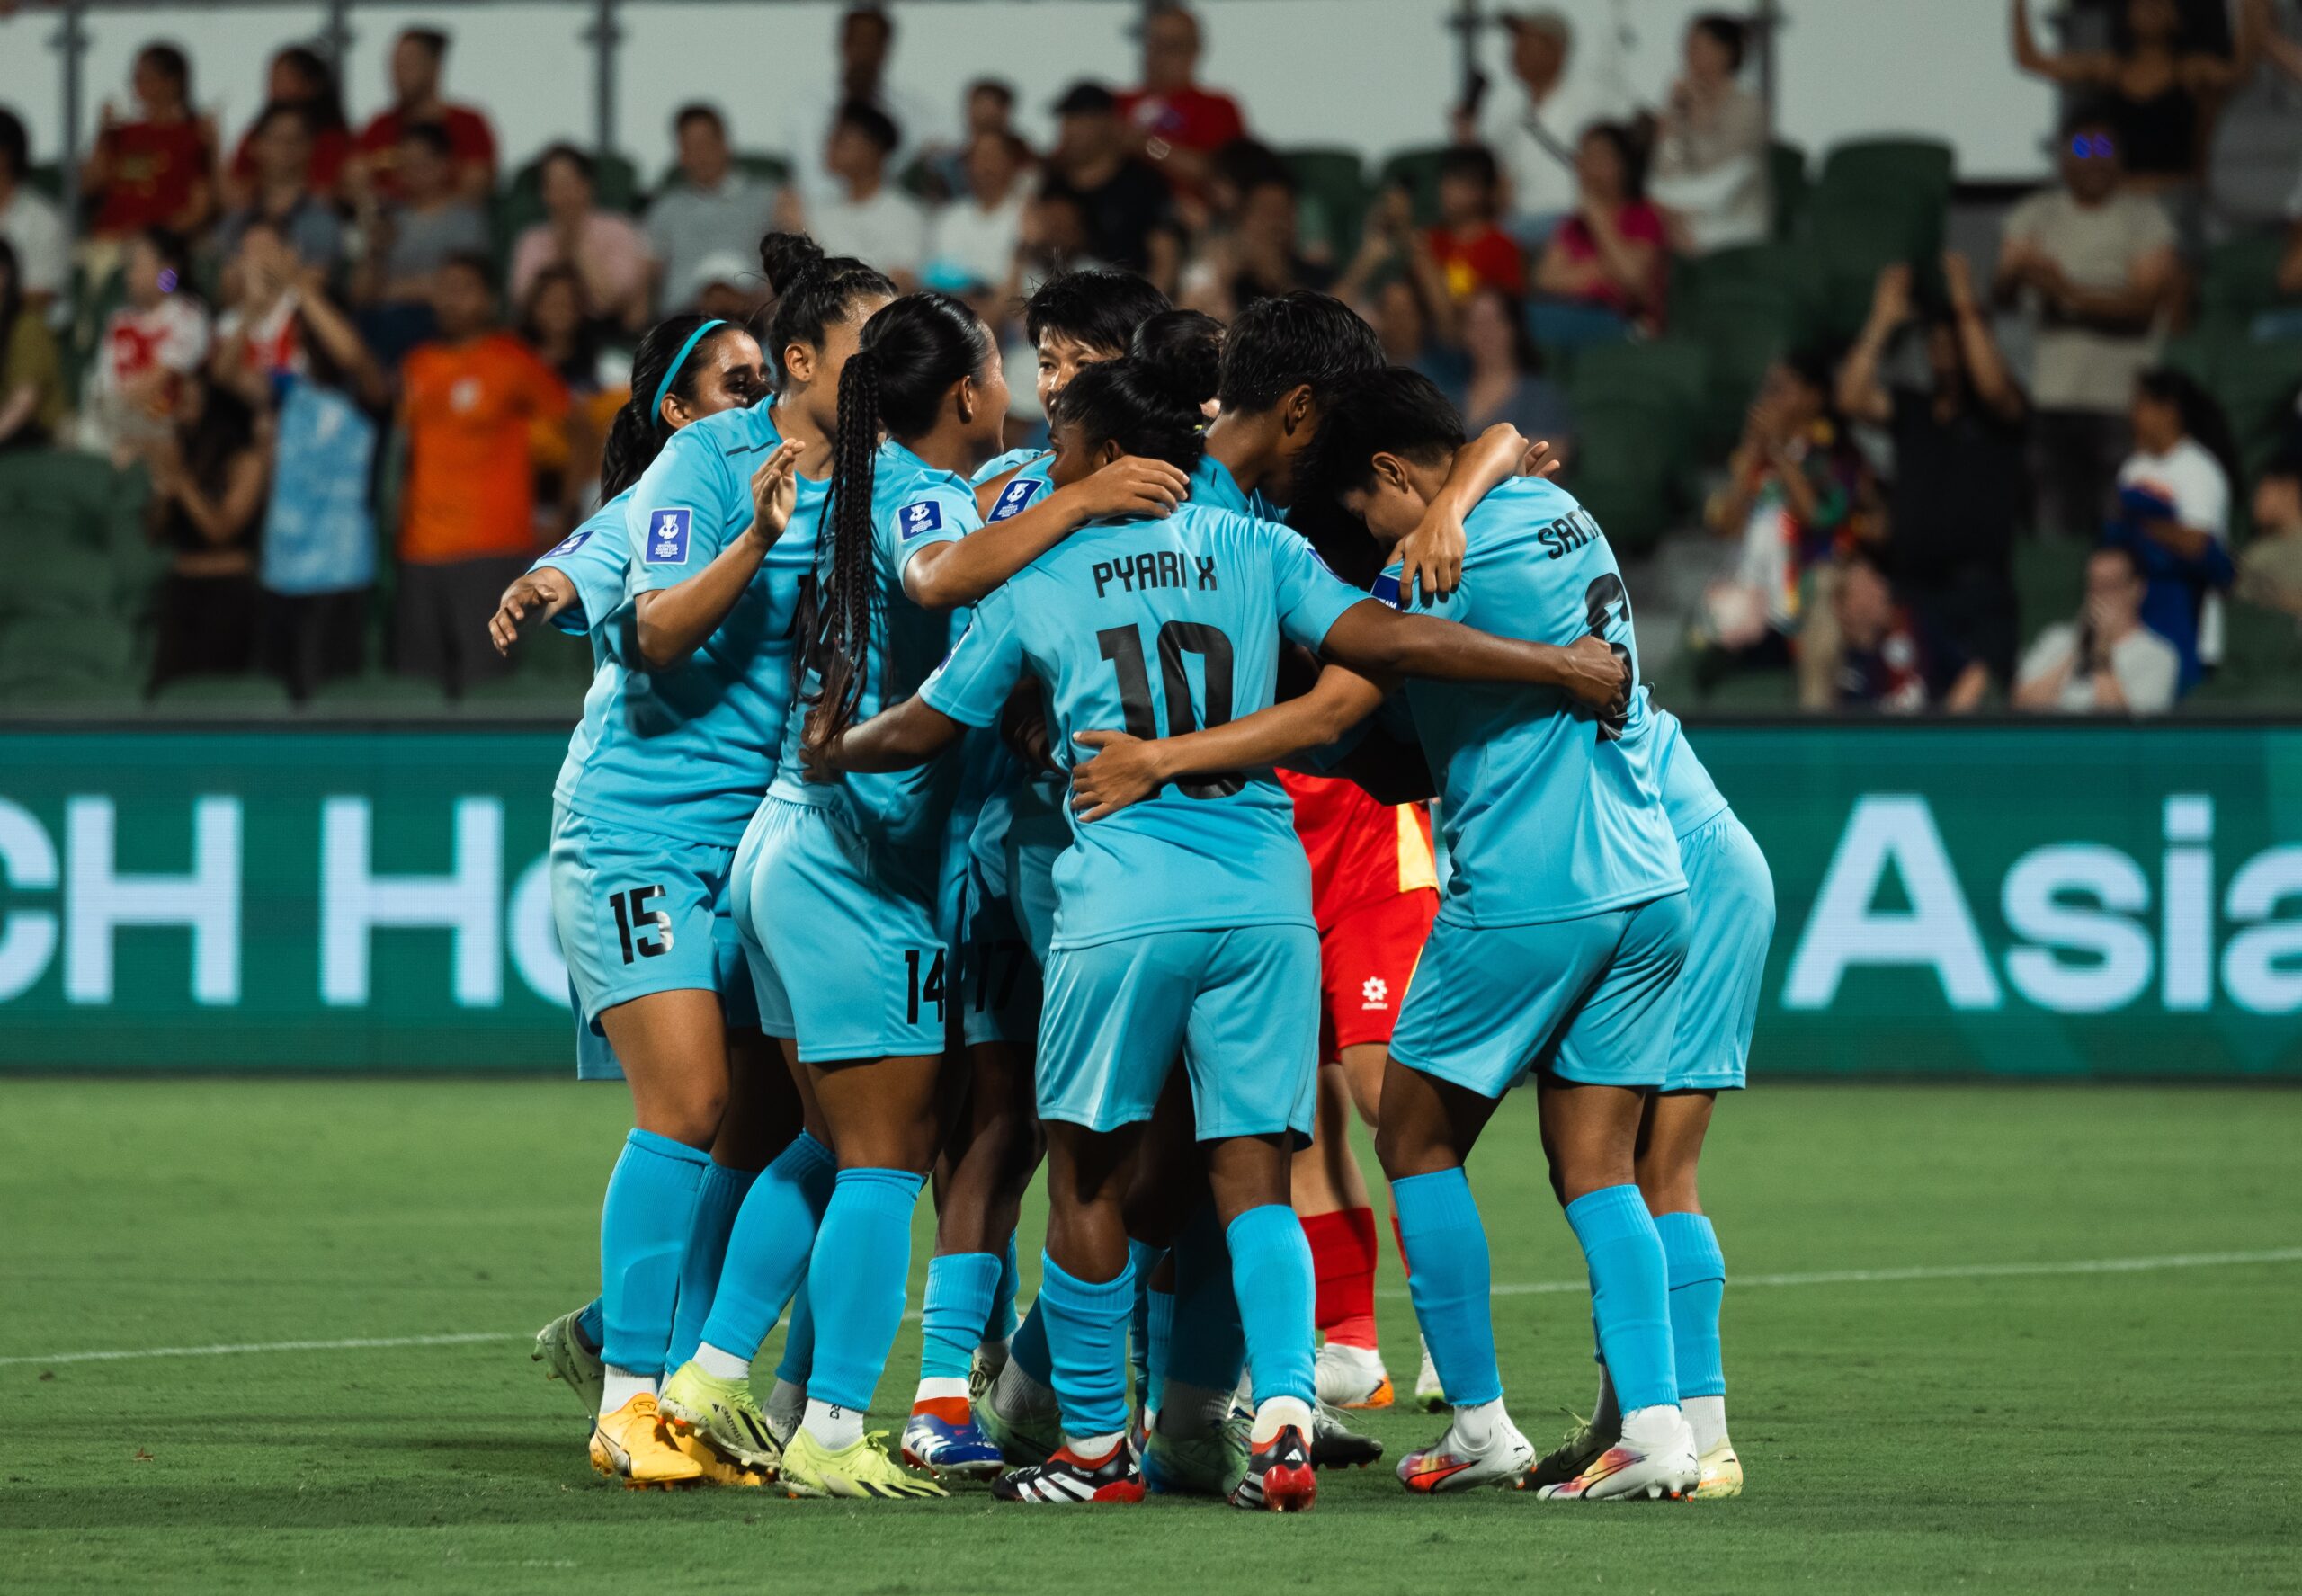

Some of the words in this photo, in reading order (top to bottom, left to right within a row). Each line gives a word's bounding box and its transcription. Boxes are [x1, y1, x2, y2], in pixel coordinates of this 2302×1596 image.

[1092, 551, 1187, 599] PYARI
[1195, 555, 1218, 591] X
[1096, 620, 1246, 800] 10
[609, 885, 674, 966] 15
[905, 948, 945, 1025] 14
